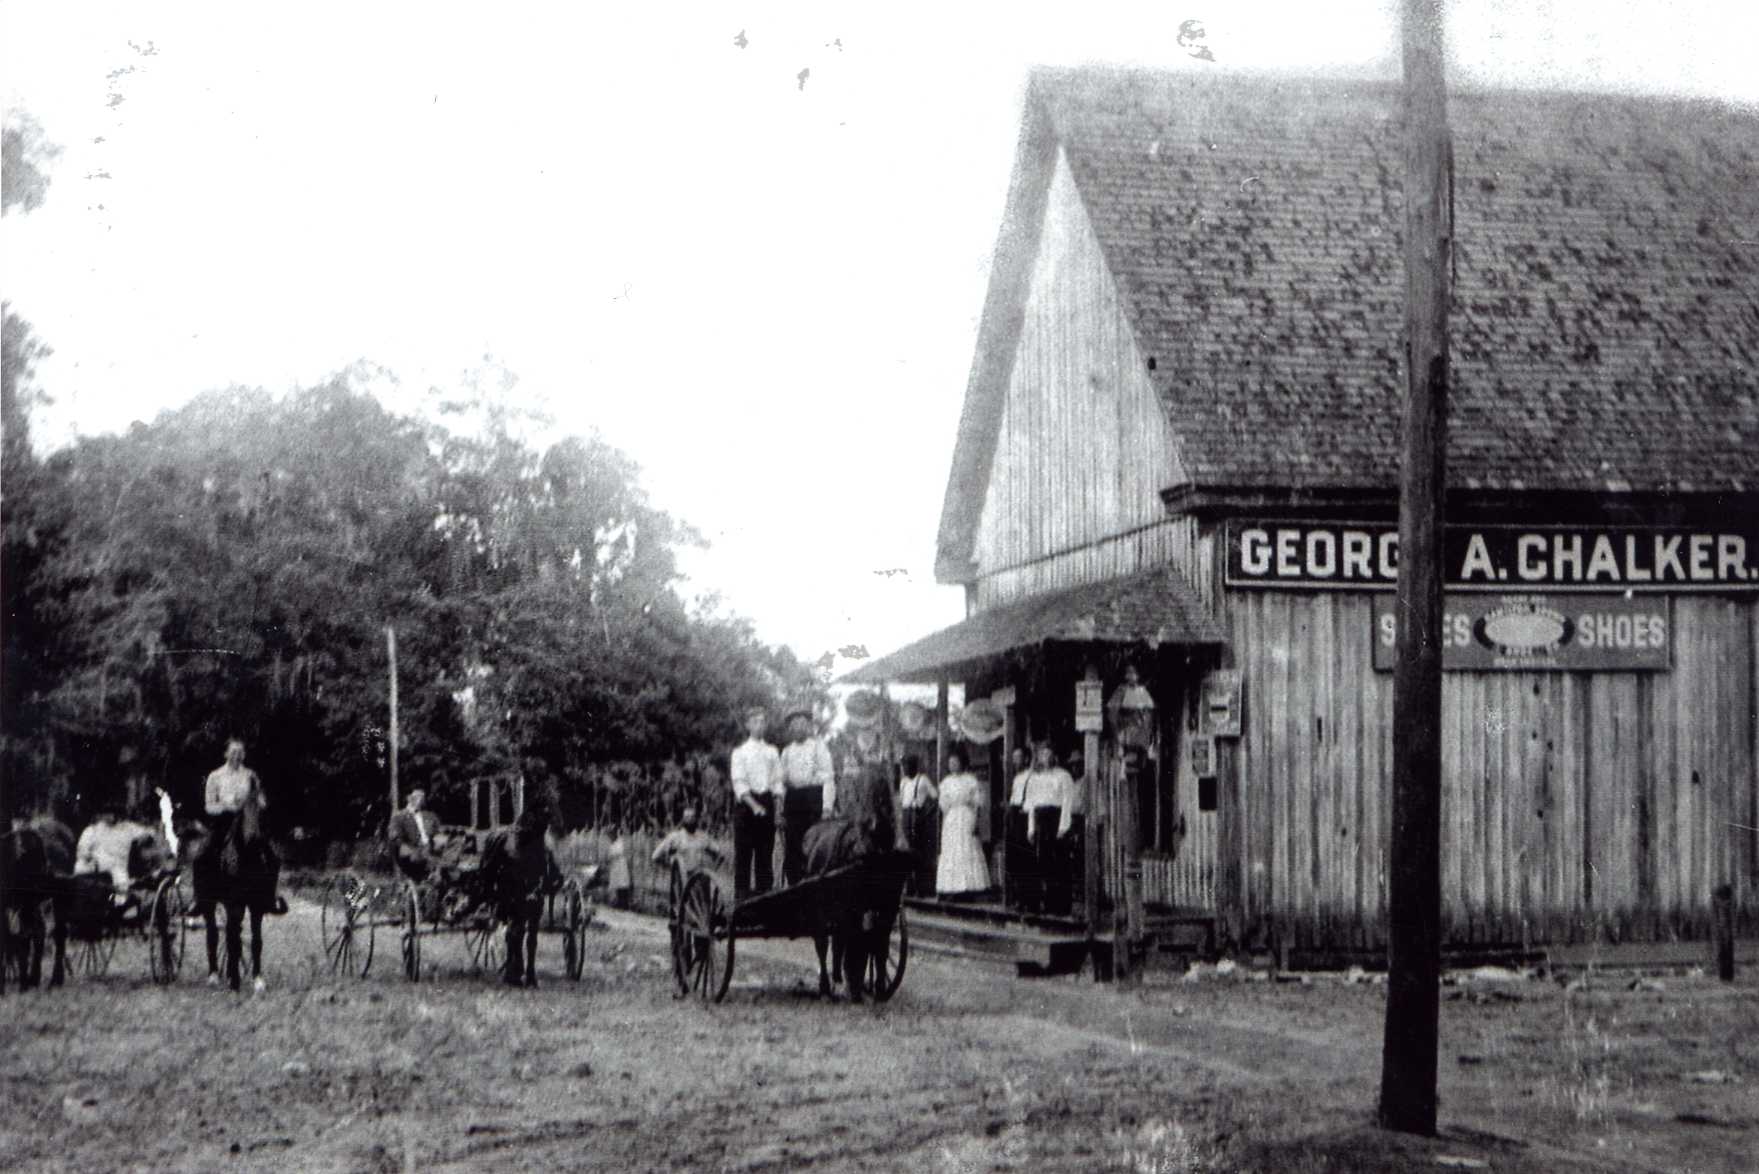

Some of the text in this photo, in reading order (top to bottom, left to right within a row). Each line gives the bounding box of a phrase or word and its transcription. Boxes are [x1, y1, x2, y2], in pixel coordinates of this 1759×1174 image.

[1241, 528, 1759, 581] GEORG A. CHALKER.
[1380, 613, 1470, 647] SES
[1577, 612, 1665, 649] SHOES
